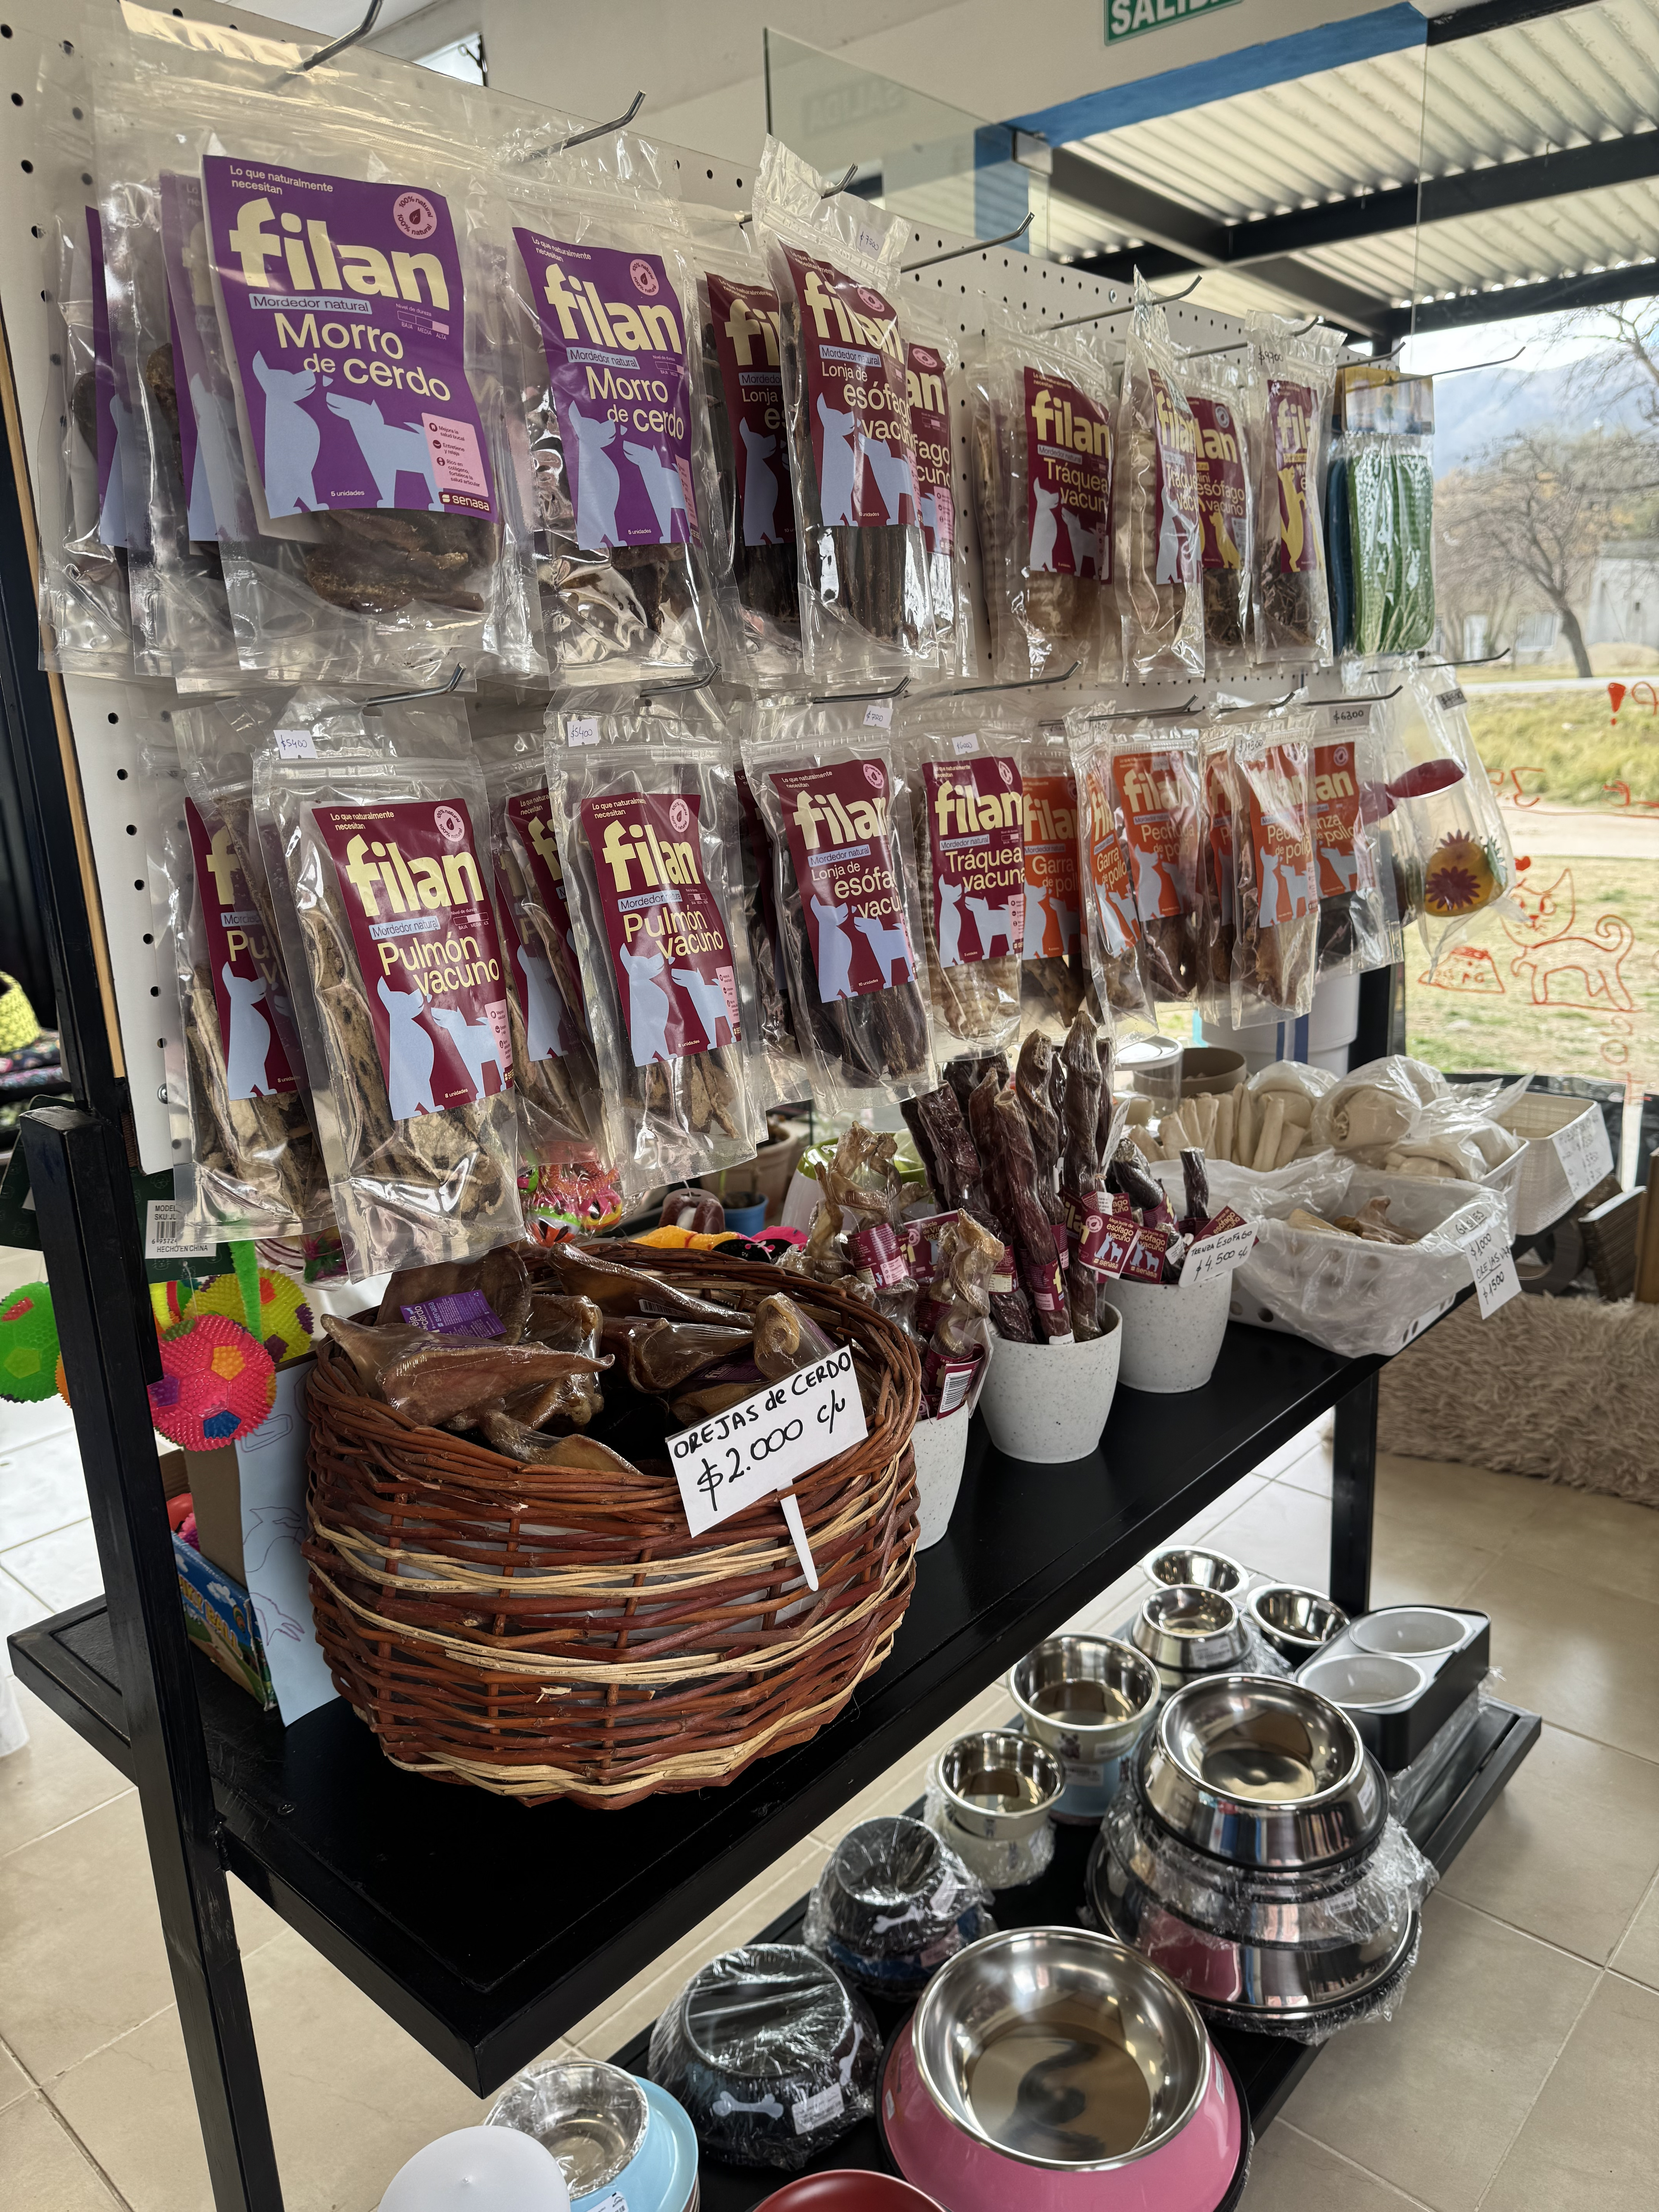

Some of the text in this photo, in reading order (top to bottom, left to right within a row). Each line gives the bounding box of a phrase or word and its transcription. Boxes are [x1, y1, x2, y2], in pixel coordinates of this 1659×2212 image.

[230, 165, 333, 192] Lo que naturalmente
[231, 180, 282, 195] necesitan
[229, 198, 450, 311] filan
[531, 236, 591, 260] Lo que naturalmente
[536, 247, 563, 262] necesitan
[253, 295, 369, 313] Mordedor natural
[544, 263, 682, 355] filan
[804, 271, 905, 365] filan
[274, 313, 404, 360] Morro
[417, 326, 432, 335] MEDIA
[570, 349, 637, 368] Mordedor natural
[821, 347, 880, 366] Mordedor natural
[304, 353, 451, 401] de cerdo
[742, 374, 781, 384] Mordedo
[822, 361, 868, 382] Lonja de
[586, 366, 668, 403] Morro
[742, 388, 778, 406] Lonja
[607, 404, 684, 440] de cerdo
[1031, 389, 1109, 459] filan
[1039, 445, 1063, 459] Mordedor
[1044, 457, 1108, 494] Tráquea
[452, 495, 489, 511] senasa
[1060, 487, 1107, 514] vacun
[1206, 500, 1243, 516] vacuno
[281, 734, 307, 750] $5400
[570, 725, 593, 741] $5400
[799, 771, 833, 781] naturalmente
[520, 799, 526, 807] Lo
[520, 805, 543, 816] necesitan
[601, 802, 613, 811] que
[934, 780, 1022, 836] filan
[330, 811, 394, 822] Lo que naturalmente
[594, 809, 626, 819] necesitan
[941, 836, 988, 849] Mordedor natural
[1153, 843, 1163, 853] de
[603, 820, 701, 892] filan
[810, 846, 869, 865] Mordedor natural
[945, 847, 1023, 873] Tráquea
[1032, 855, 1074, 874] Garra
[1097, 847, 1120, 872] Garra
[345, 834, 484, 917] filan
[811, 861, 860, 881] Lonja de
[1108, 860, 1127, 890] pollo
[1042, 870, 1078, 897] de poll
[621, 895, 664, 909] Mordedor
[372, 918, 438, 938] Mordedor natural
[623, 905, 708, 943] Pulmón
[377, 932, 481, 975] Pulmón
[655, 931, 723, 959] vacuno
[413, 958, 500, 996] vacuno
[682, 1039, 700, 1047] unidades
[449, 1088, 468, 1097] unidades
[1106, 1223, 1133, 1238] esófago
[1191, 1243, 1214, 1257] TRENZA
[1099, 1260, 1118, 1269] senasa
[415, 1306, 429, 1326] cerdo
[428, 1302, 441, 1321] senasa
[705, 1363, 733, 1379] filan
[673, 1352, 851, 1458] OREJAS de CERDO
[697, 1389, 845, 1512] $2.000 c/u
